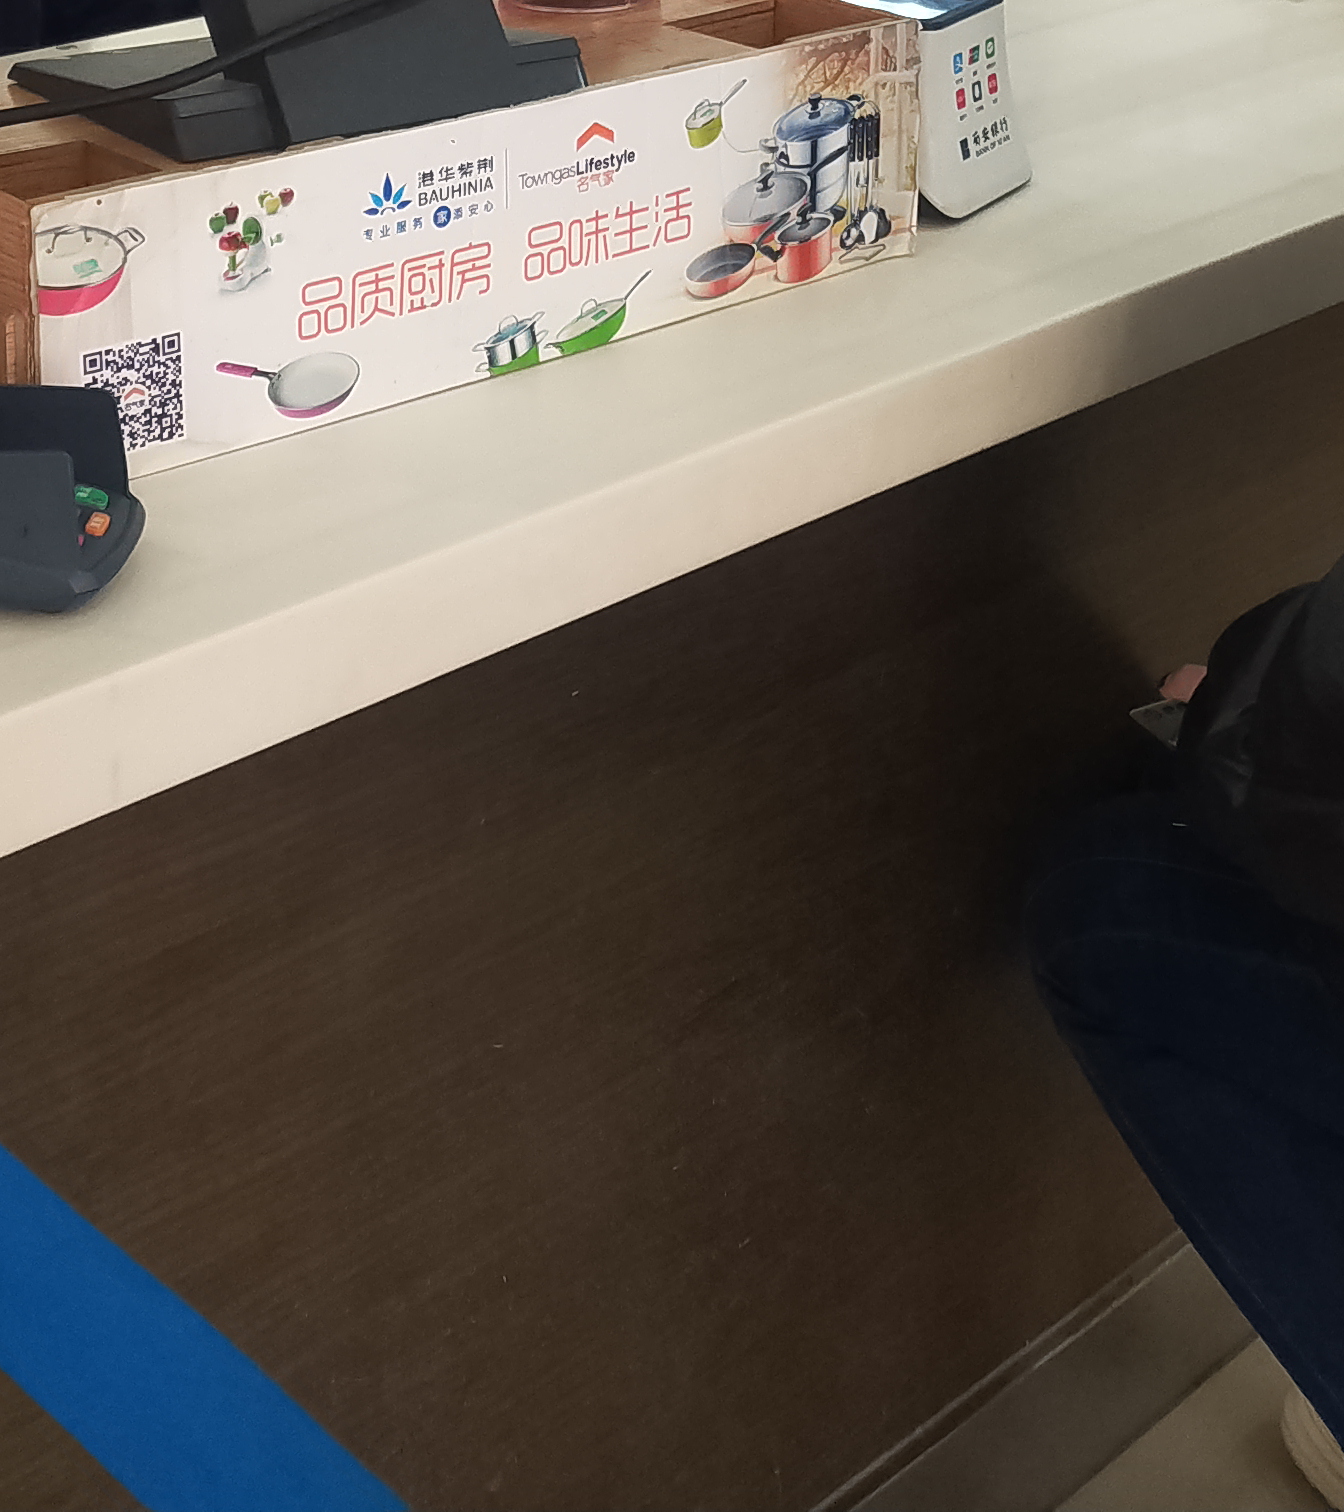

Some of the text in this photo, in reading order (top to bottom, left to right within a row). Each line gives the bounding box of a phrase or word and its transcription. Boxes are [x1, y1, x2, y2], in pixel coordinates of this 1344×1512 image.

[518, 148, 637, 190] TowngasLifestyle
[418, 176, 494, 207] BAUHINIA
[298, 185, 694, 342] 品质厨房 品味生活
